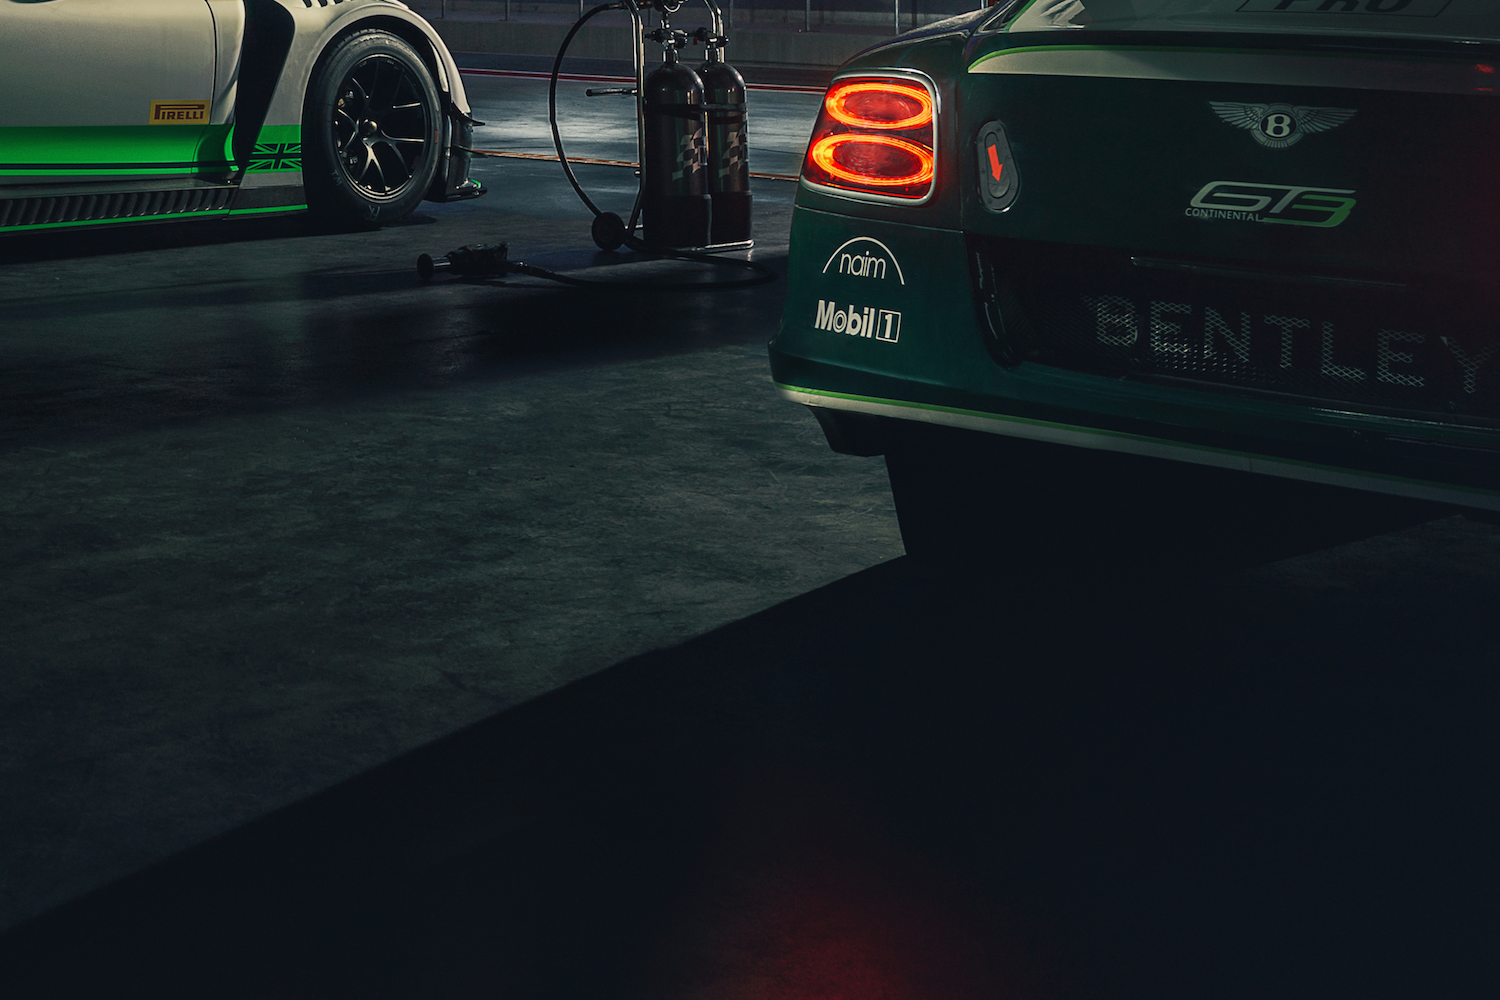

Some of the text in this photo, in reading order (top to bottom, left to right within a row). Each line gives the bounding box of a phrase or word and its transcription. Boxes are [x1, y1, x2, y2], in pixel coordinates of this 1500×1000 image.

[153, 104, 207, 121] PIRELLI
[1184, 207, 1262, 223] CONTINENTAL
[838, 250, 887, 279] naim
[814, 299, 876, 339] Mobil
[1095, 294, 1500, 394] BENTLEY
